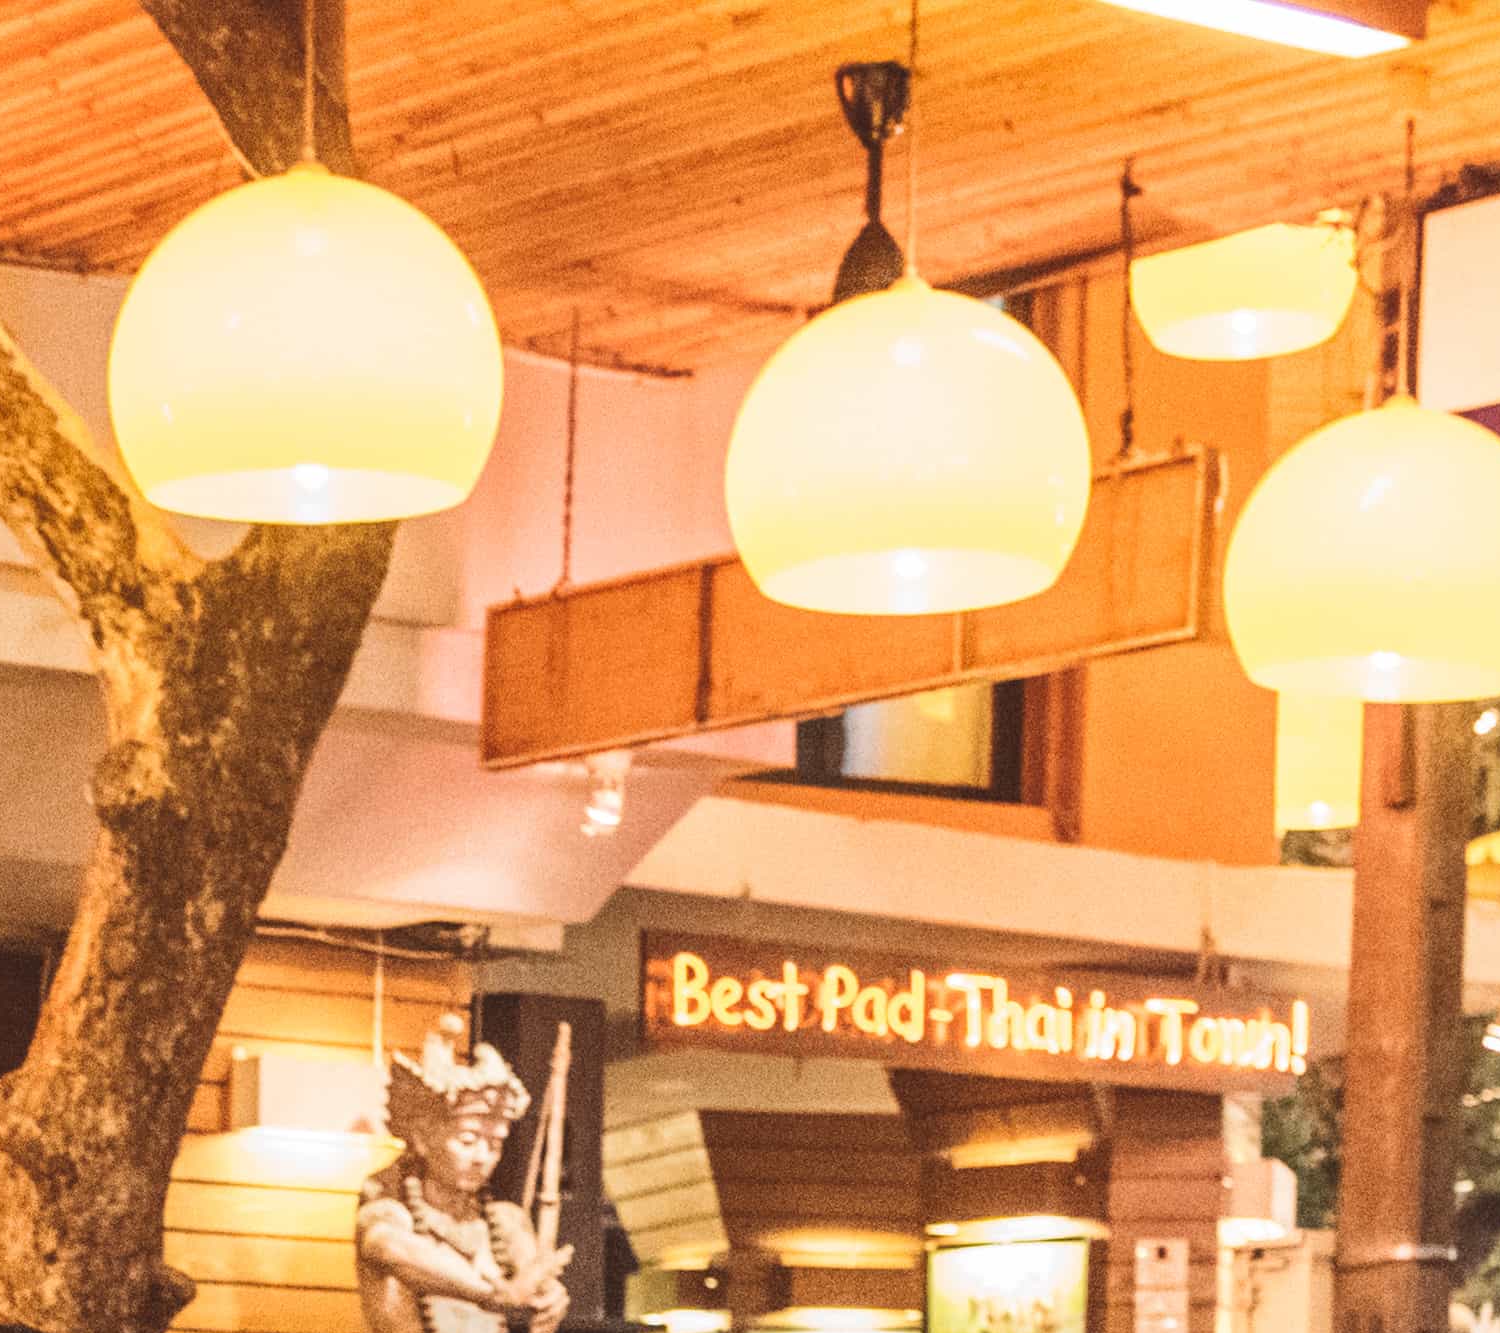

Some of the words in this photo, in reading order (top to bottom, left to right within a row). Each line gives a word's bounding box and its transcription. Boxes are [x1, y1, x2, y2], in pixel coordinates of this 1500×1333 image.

[673, 952, 810, 1033] Best
[820, 963, 1074, 1056] Pad-Thai
[1084, 989, 1137, 1062] in
[1144, 997, 1310, 1076] Town!
